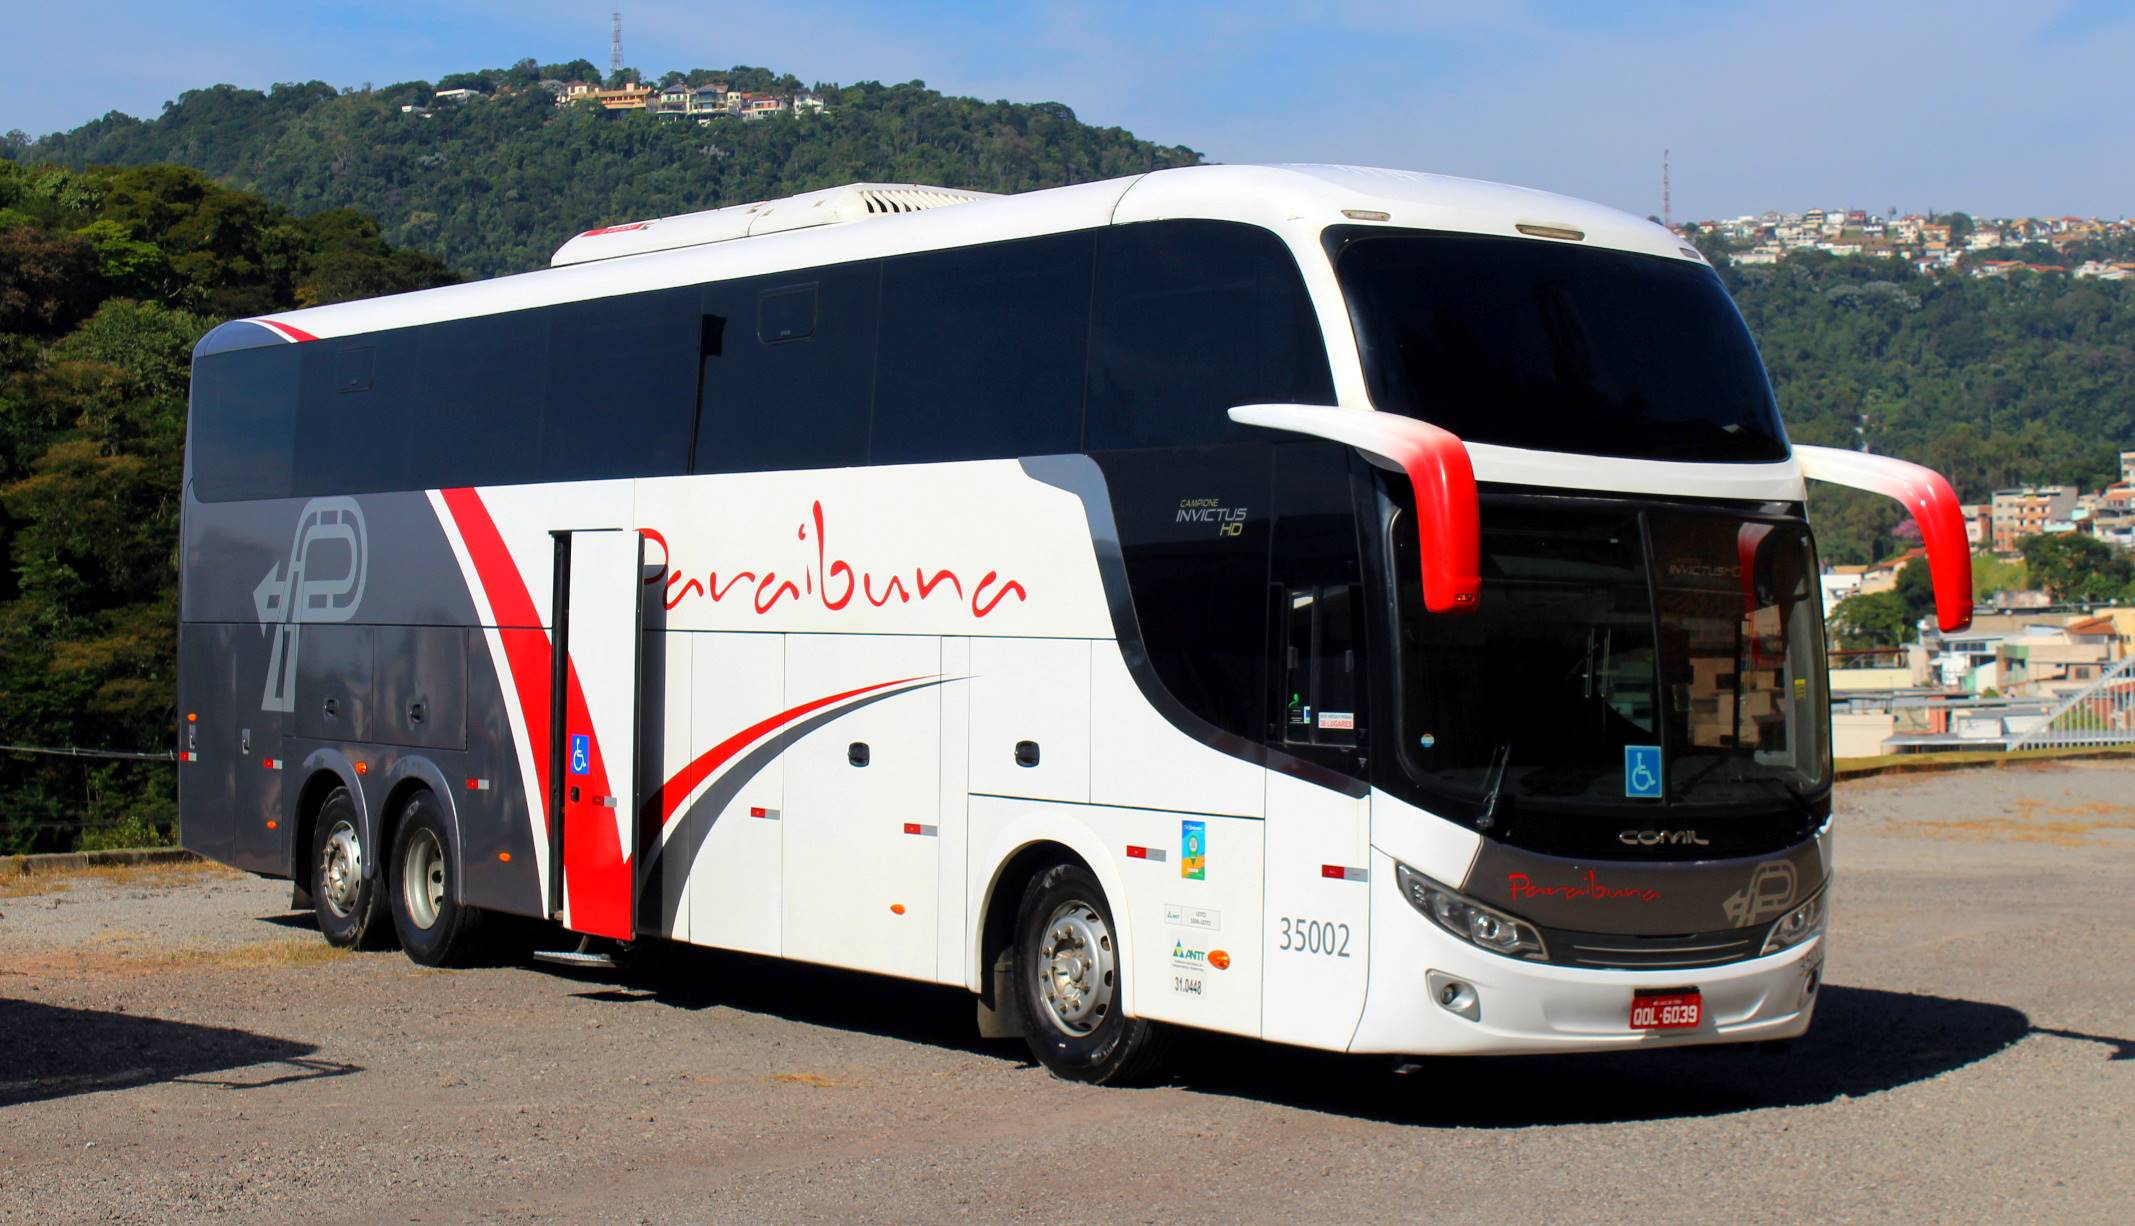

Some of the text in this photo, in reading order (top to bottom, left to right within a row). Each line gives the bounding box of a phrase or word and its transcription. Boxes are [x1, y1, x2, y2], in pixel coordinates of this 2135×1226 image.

[1180, 498, 1219, 508] CAMPIONE
[1176, 507, 1248, 522] INVICTUS
[1219, 522, 1243, 536] HD
[1618, 830, 1709, 845] COMIL
[1279, 917, 1350, 958] 35002
[1185, 949, 1206, 961] ANTT
